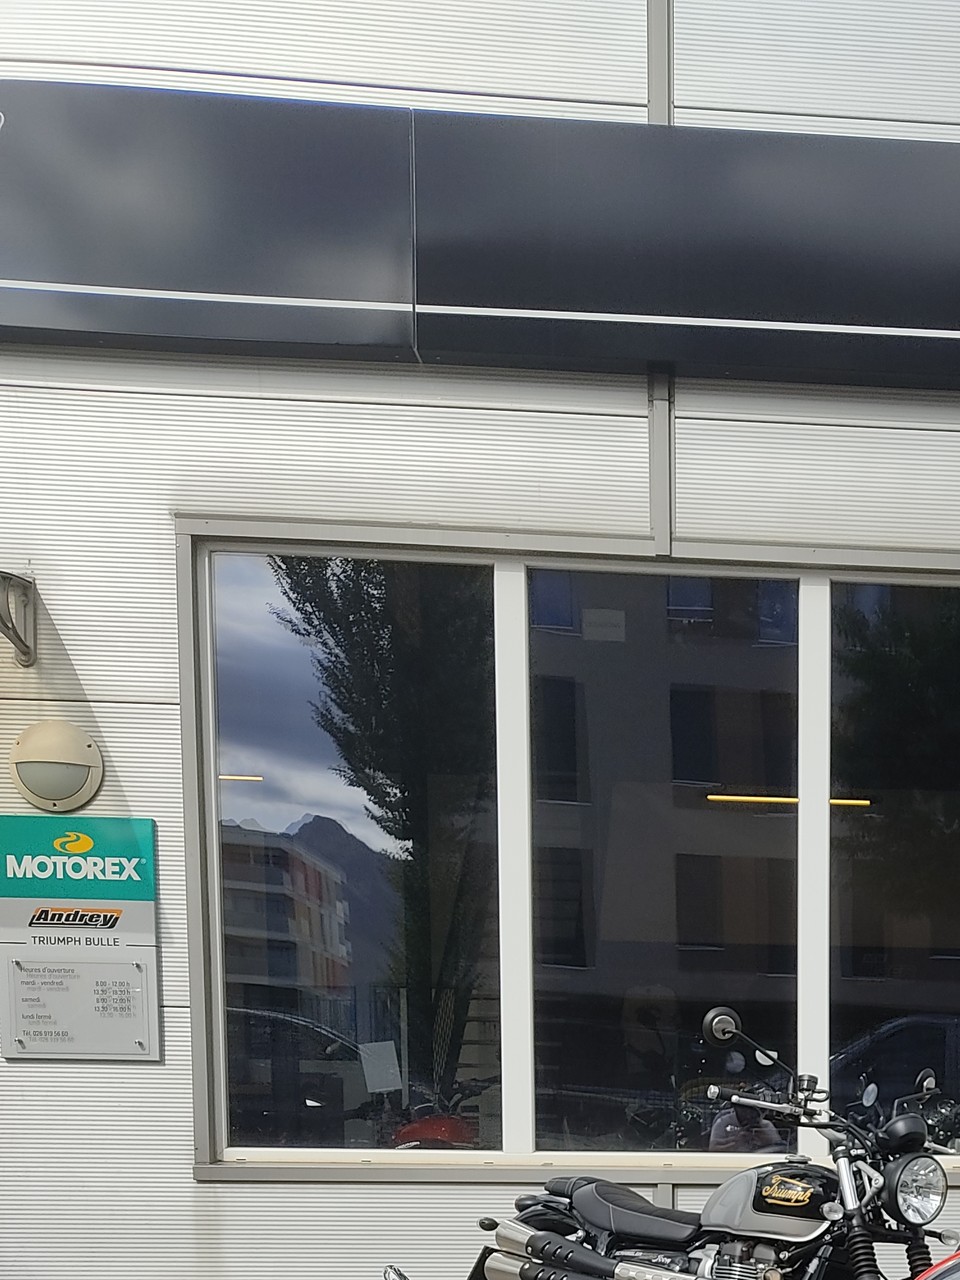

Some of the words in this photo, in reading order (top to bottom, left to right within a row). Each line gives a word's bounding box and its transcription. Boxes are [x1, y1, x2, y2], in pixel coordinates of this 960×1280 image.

[6, 855, 141, 880] MOTOREX
[34, 909, 114, 927] Andrey
[31, 936, 81, 946] TRIUMPH
[85, 938, 120, 947] BULLE
